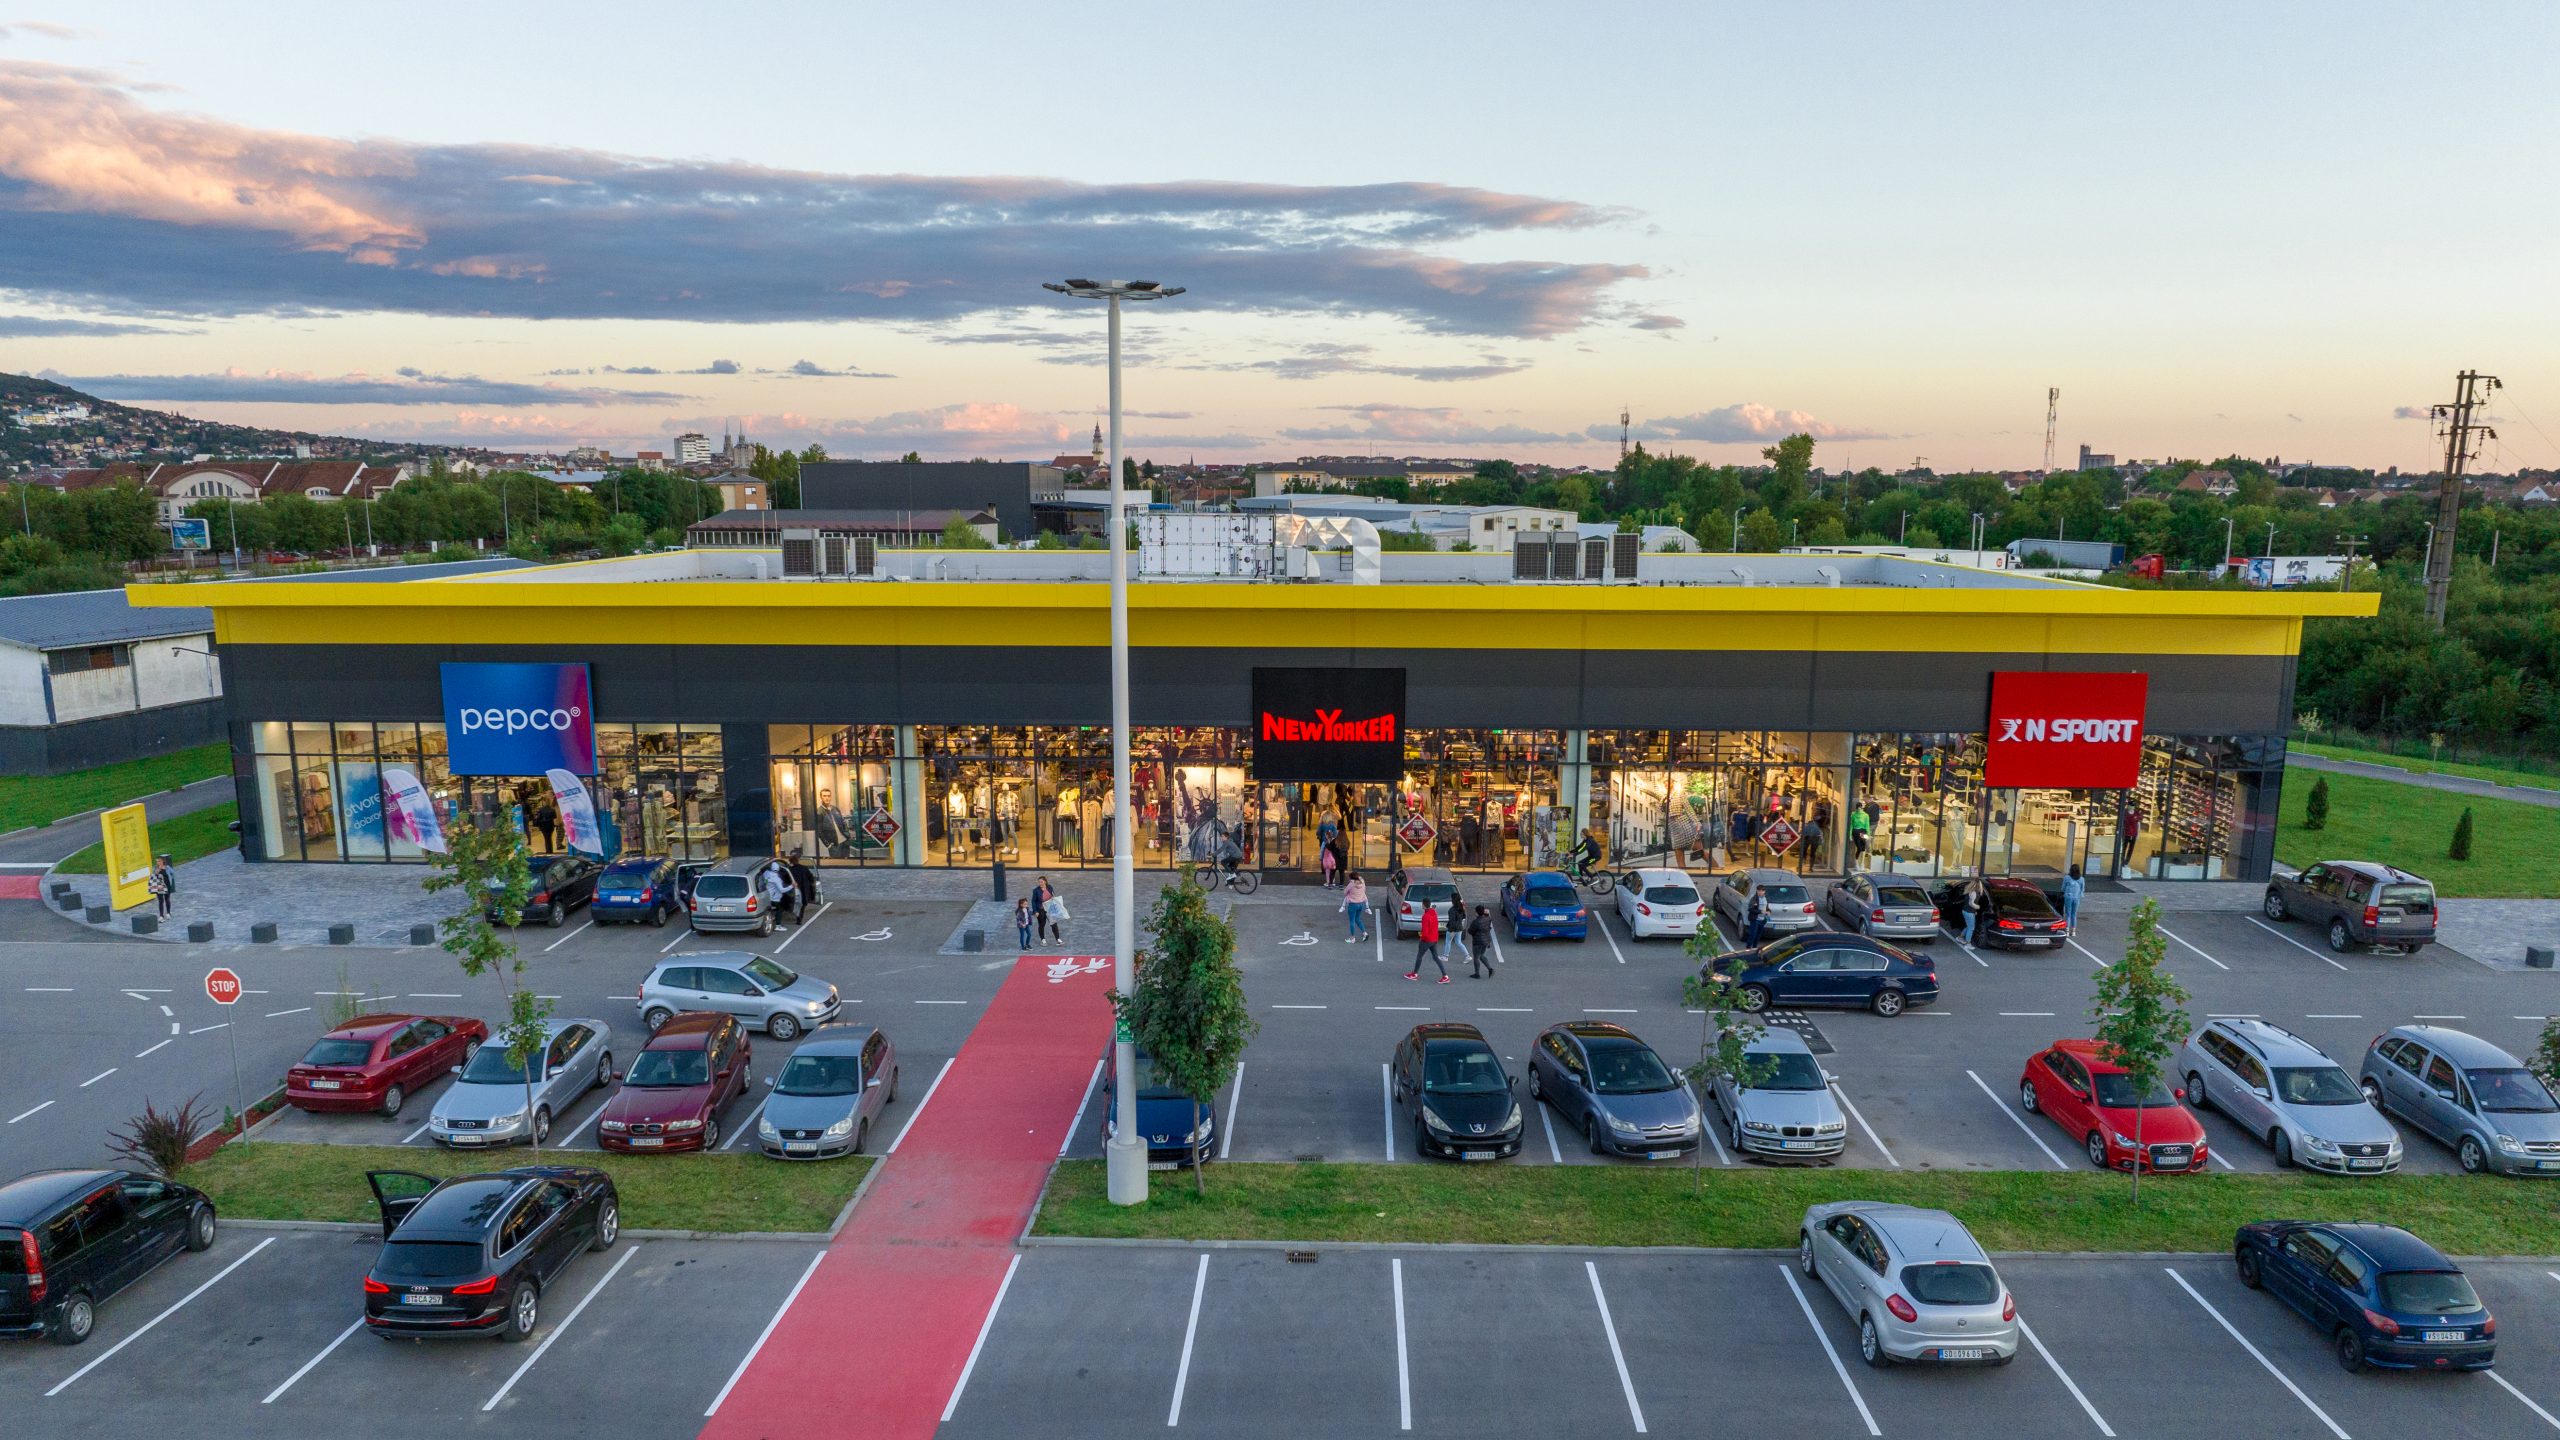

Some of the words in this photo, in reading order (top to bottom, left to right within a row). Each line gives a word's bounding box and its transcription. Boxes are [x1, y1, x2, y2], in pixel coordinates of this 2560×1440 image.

[460, 708, 572, 735] pepco
[2025, 718, 2046, 742] N
[2049, 718, 2139, 743] SPORT
[211, 980, 236, 993] STOP
